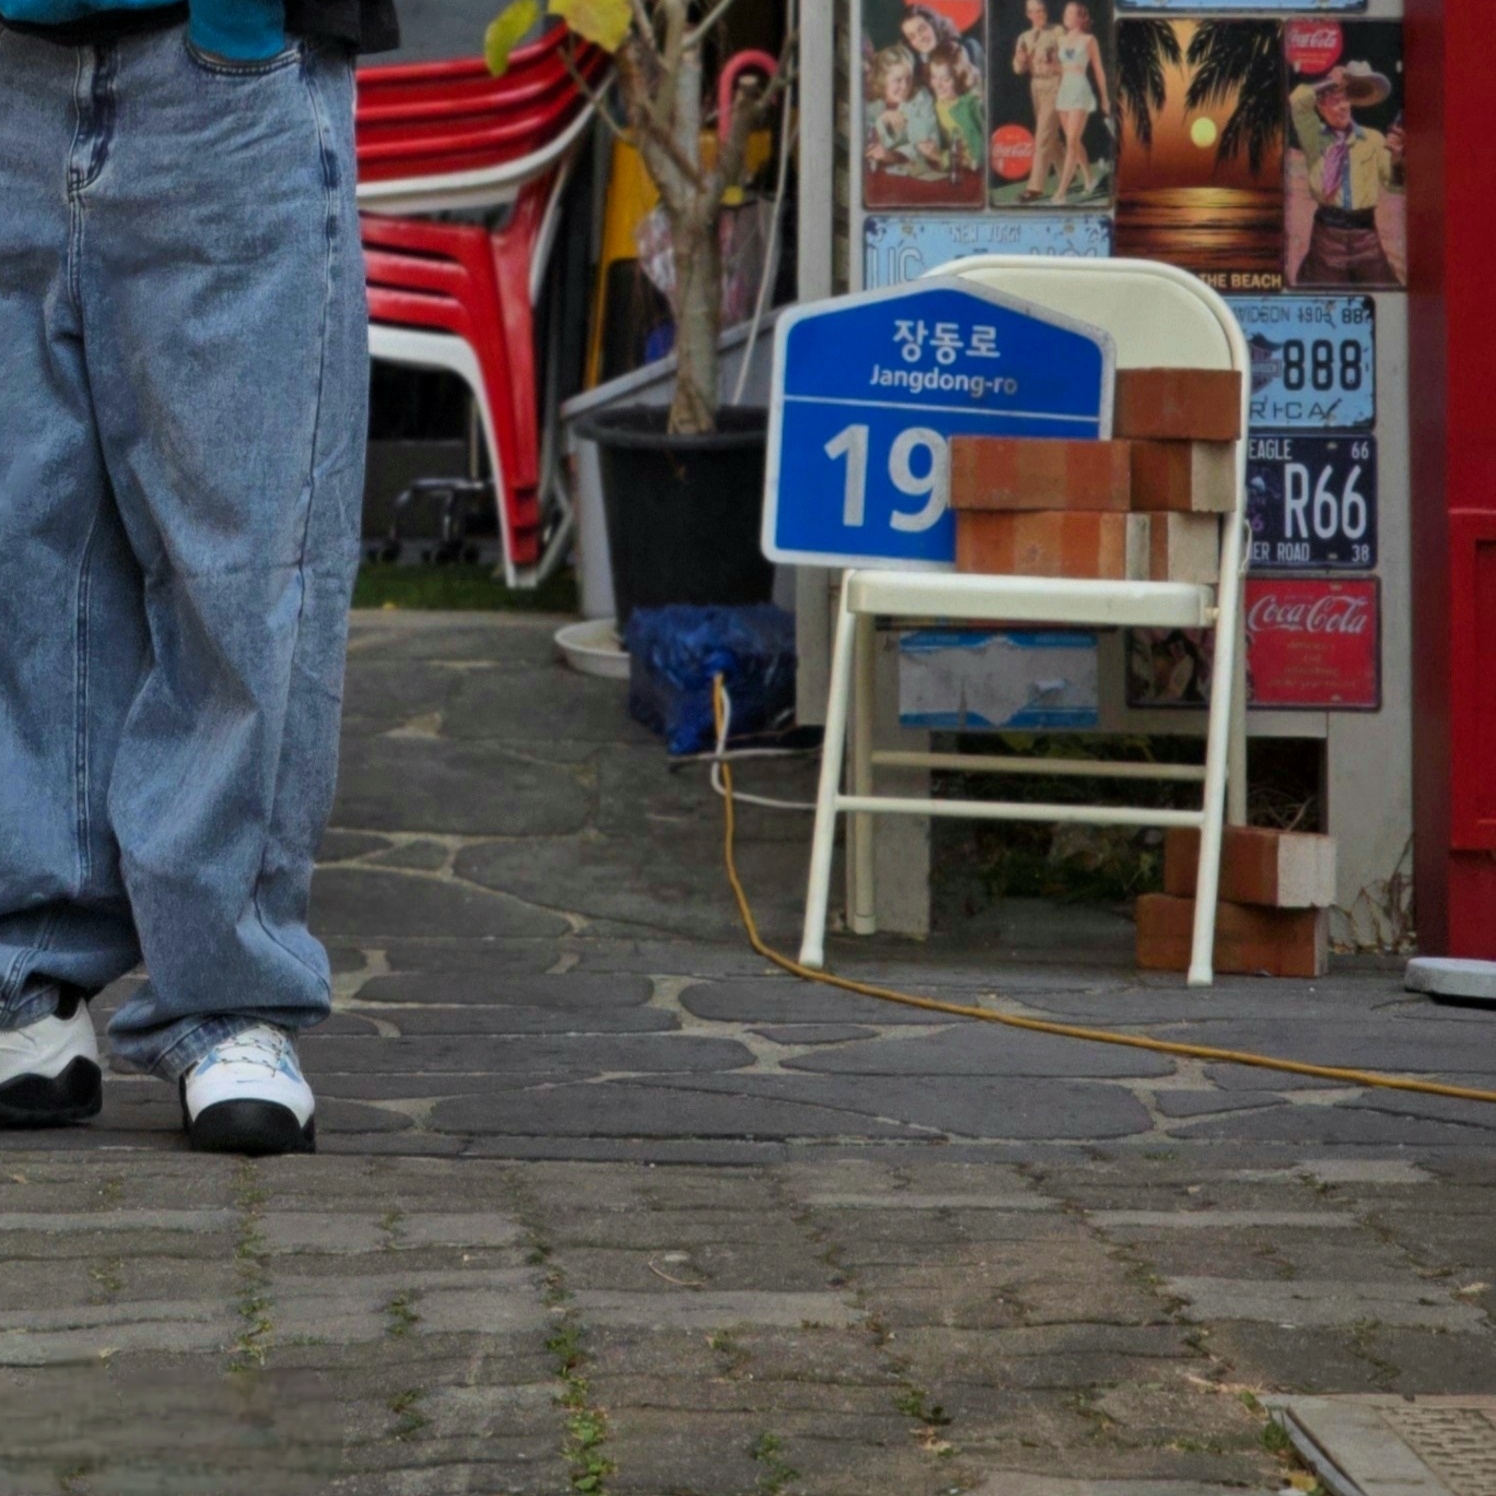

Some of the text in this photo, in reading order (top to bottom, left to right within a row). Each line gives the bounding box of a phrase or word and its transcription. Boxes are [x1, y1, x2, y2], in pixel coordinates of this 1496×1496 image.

[1231, 273, 1282, 288] BEACH
[893, 320, 1001, 364] 장동로
[870, 364, 1018, 397] Jangdong-ro
[1283, 339, 1362, 391] 888
[1249, 439, 1369, 460] EAGLE 66
[1285, 463, 1367, 539] R66
[1277, 542, 1310, 561] ROAD
[1352, 545, 1370, 562] 38
